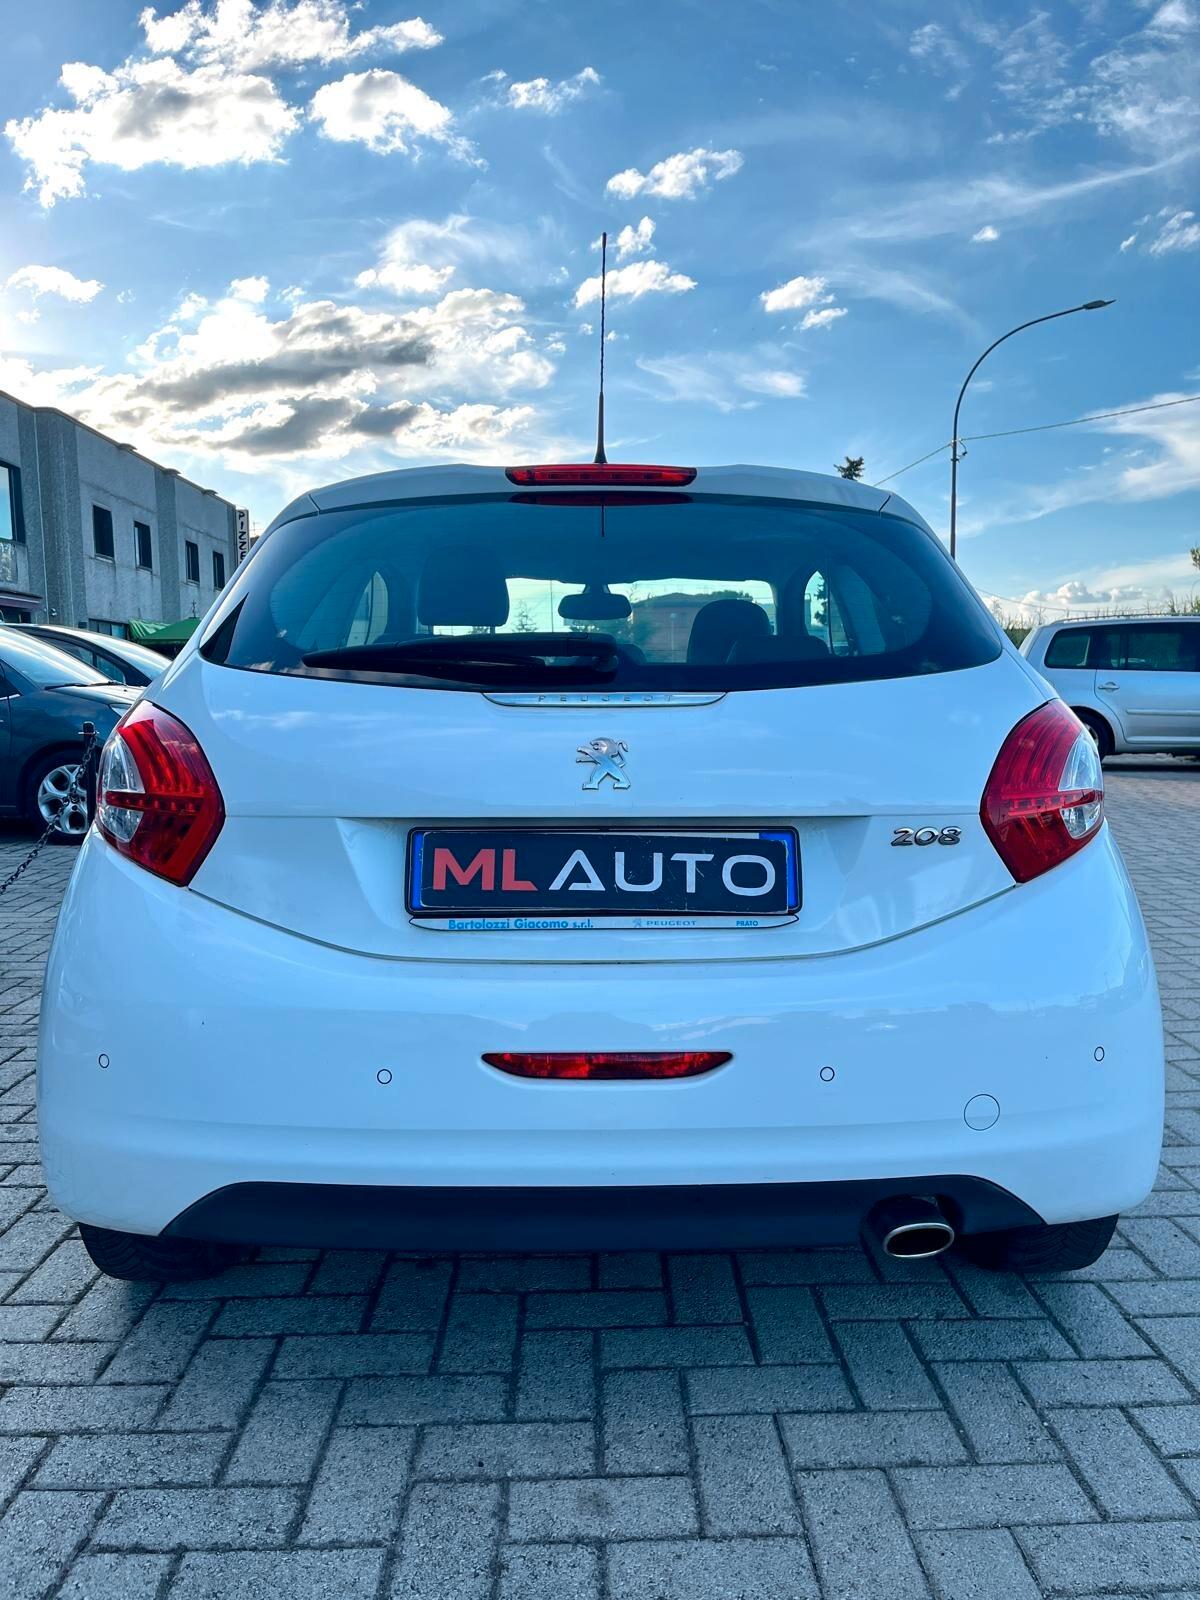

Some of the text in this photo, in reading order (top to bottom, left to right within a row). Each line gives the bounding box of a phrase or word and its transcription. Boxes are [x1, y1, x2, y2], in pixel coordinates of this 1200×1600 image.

[238, 510, 247, 564] PIZZE
[890, 825, 962, 847] 208
[432, 847, 776, 897] ML AUTO
[448, 918, 594, 930] Bartolozzi Giacomo s.r.l.
[646, 919, 697, 927] PEUGEOT
[735, 919, 759, 927] PRATO
